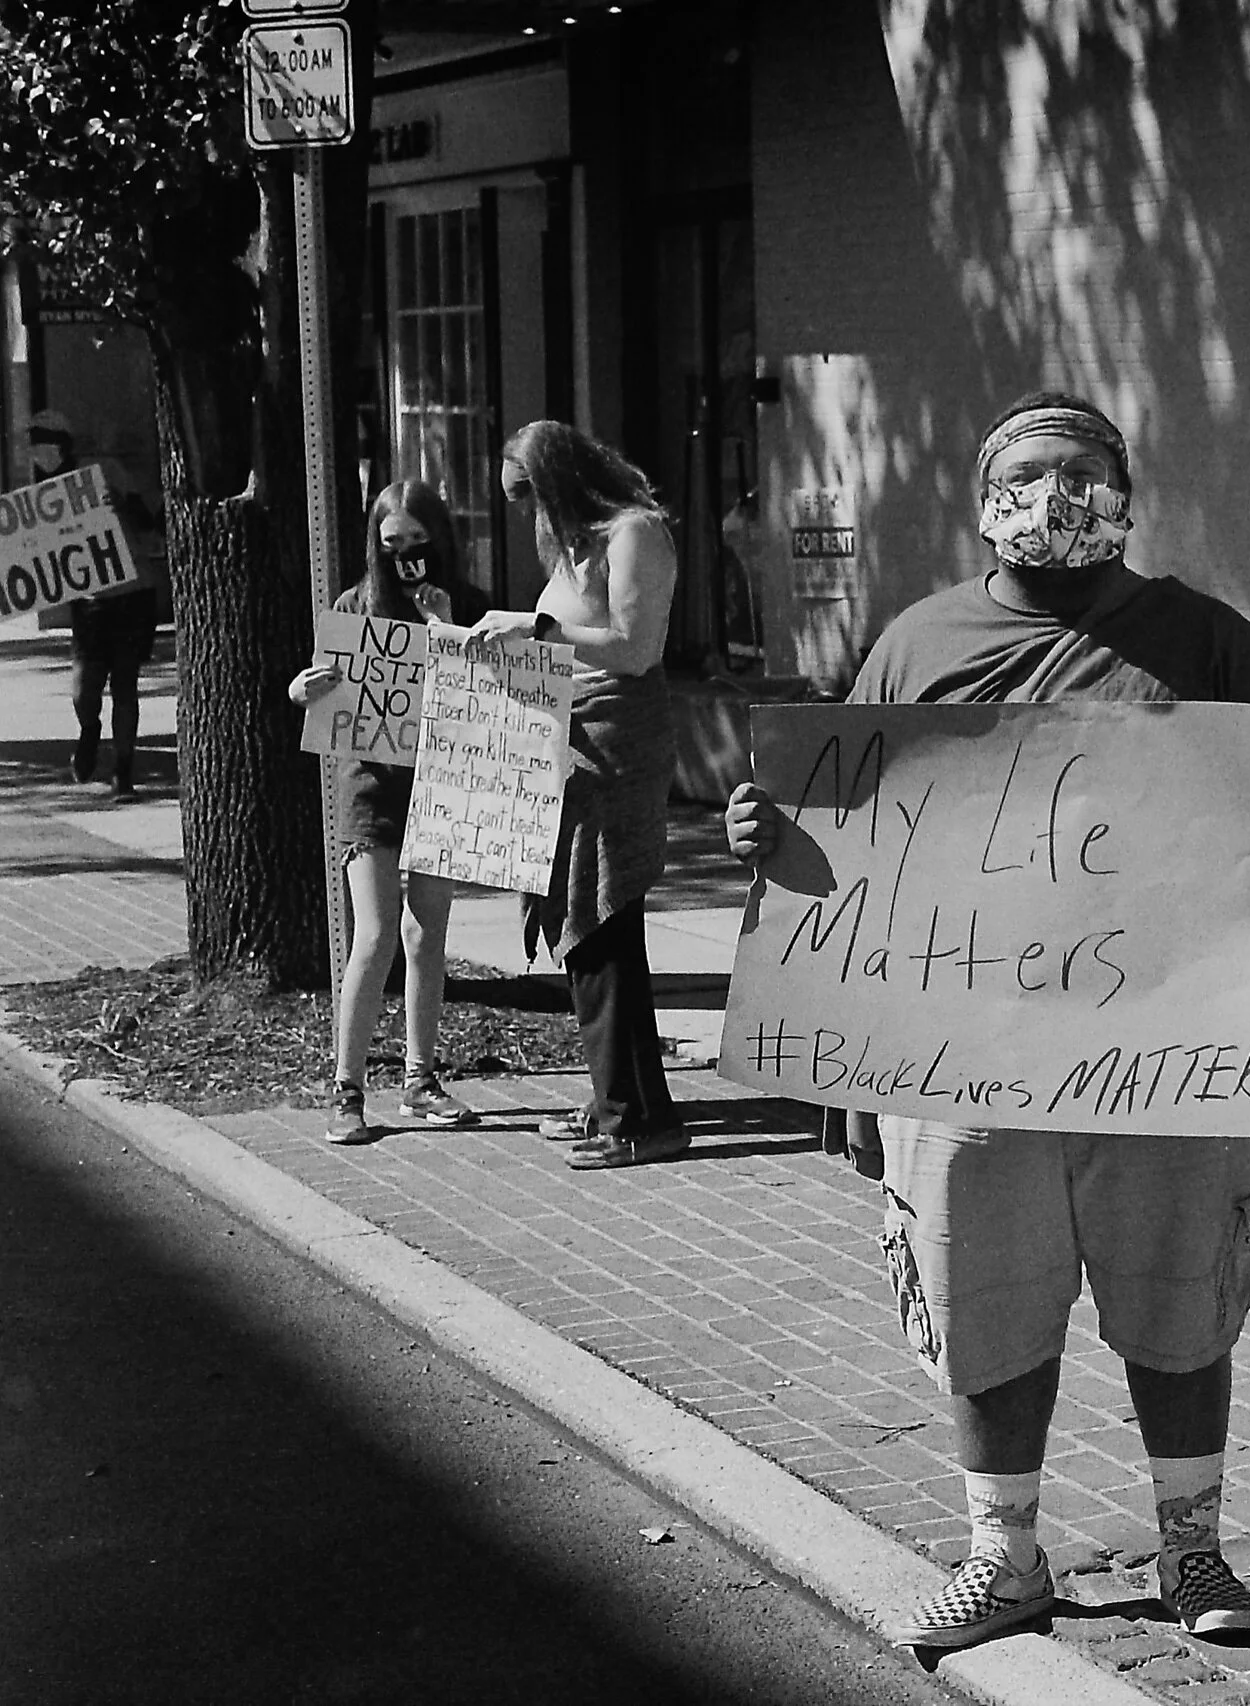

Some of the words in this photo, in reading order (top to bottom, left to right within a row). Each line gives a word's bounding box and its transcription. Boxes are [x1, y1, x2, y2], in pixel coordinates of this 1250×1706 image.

[265, 50, 308, 73] 12:00
[311, 48, 332, 71] AM
[258, 97, 276, 120] TO
[320, 94, 340, 117] AM
[359, 616, 411, 658] NO
[500, 640, 536, 671] hurts
[357, 682, 411, 719] NO
[427, 654, 466, 690] Please
[465, 661, 477, 693] I
[507, 669, 558, 708] breathe
[503, 699, 526, 732] kill
[529, 722, 552, 737] me
[421, 715, 456, 765] They
[486, 729, 506, 763] kill
[508, 753, 525, 766] me
[529, 756, 552, 771] man
[469, 760, 511, 797] breathe
[512, 768, 541, 811] They
[411, 786, 432, 818] kill
[433, 804, 453, 821] me
[463, 789, 475, 824] I
[510, 800, 552, 839] breathe
[407, 813, 446, 846] Please
[466, 826, 484, 855] I
[795, 731, 934, 941] My
[981, 740, 1118, 883] Life
[782, 877, 1125, 1008] Matters
